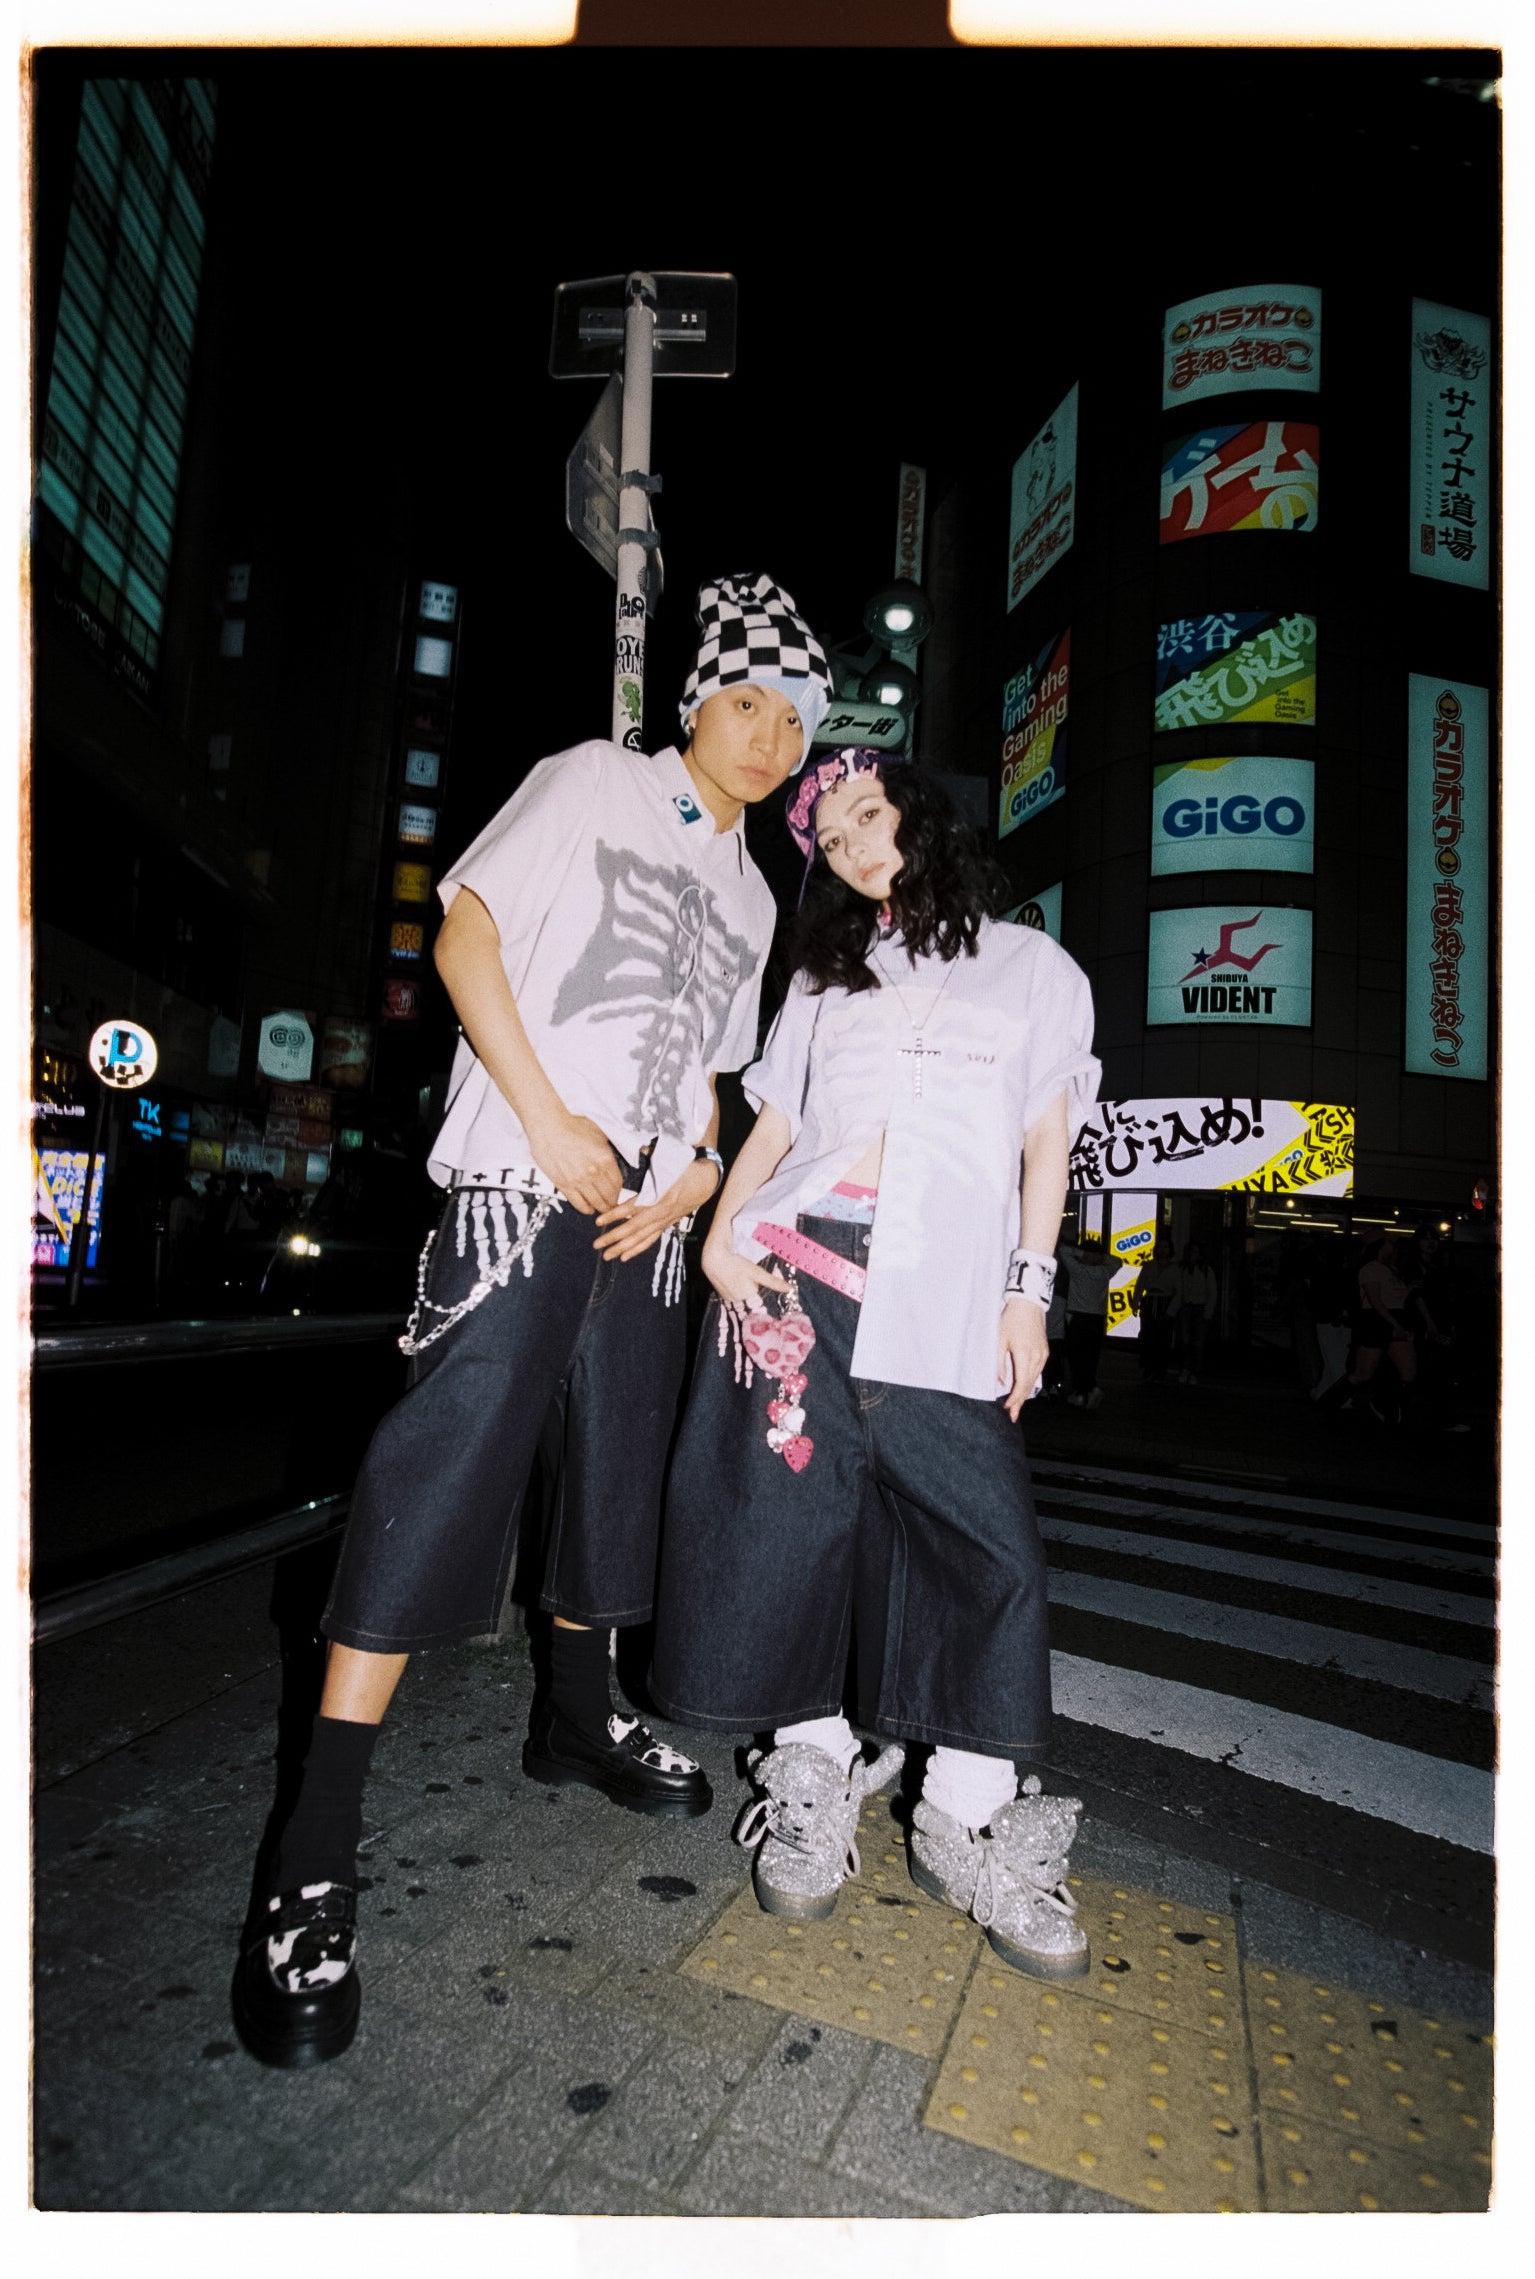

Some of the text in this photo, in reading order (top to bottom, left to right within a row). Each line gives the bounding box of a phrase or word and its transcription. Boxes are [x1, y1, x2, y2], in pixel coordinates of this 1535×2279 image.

[1191, 302, 1295, 340] カラオケ
[1169, 338, 1312, 390] まねきねこ
[1439, 387, 1477, 562] サウナ道場
[1156, 612, 1241, 661] 渋谷
[1003, 663, 1034, 704] Get
[1154, 612, 1317, 730] 飛び込め
[1007, 664, 1069, 733] into the
[1002, 694, 1068, 762] Gaming
[1001, 741, 1048, 788] Oasis
[1010, 770, 1051, 818] GiGO
[1163, 795, 1305, 838] GiGO
[1431, 719, 1465, 1067] カラオケ まねきねこ
[1182, 986, 1277, 1014] VIDENT
[1211, 973, 1249, 983] SHIBUYA
[1116, 1231, 1152, 1252] GiGO
